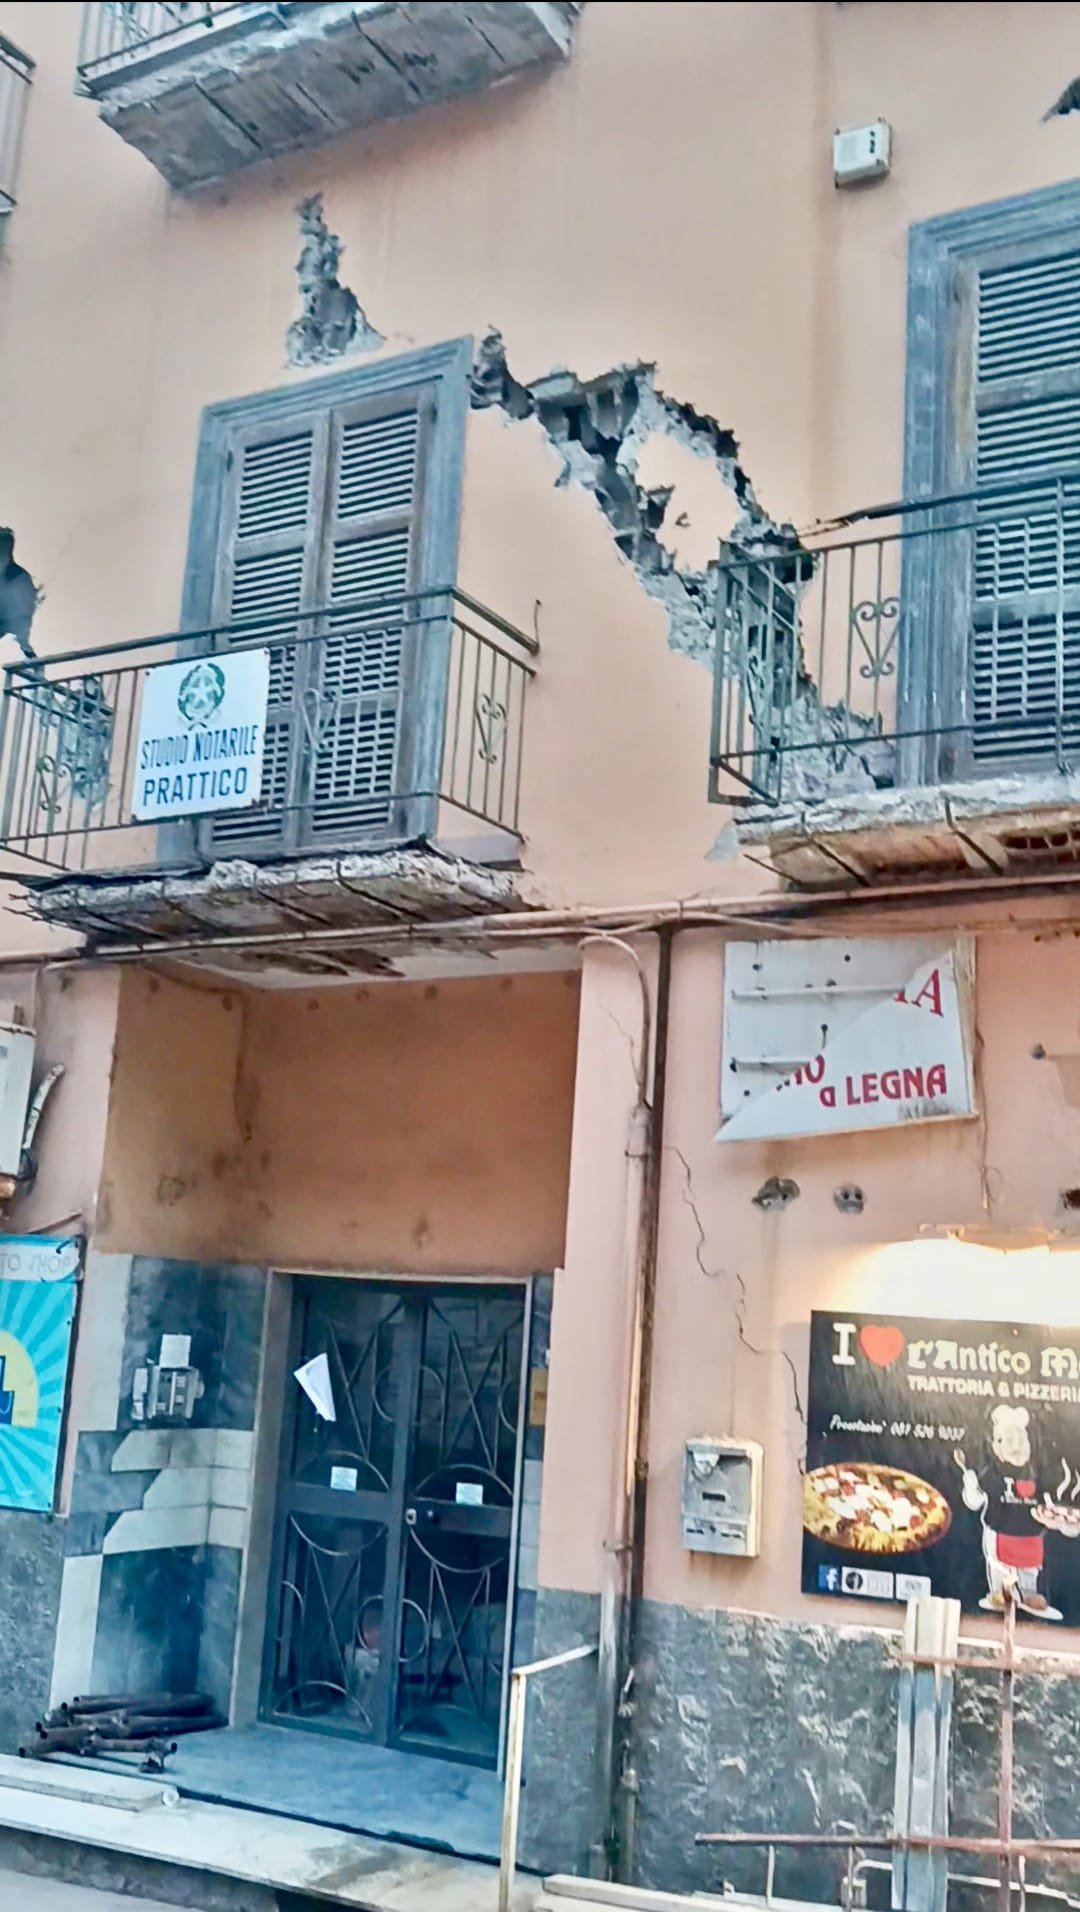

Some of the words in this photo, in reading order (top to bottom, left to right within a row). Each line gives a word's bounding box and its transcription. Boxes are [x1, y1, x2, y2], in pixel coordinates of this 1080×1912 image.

[140, 734, 188, 769] STUDIO
[193, 724, 259, 762] NOTARILE
[143, 767, 248, 806] PRATTICO
[845, 1063, 948, 1106] LEGNA
[832, 1322, 857, 1366] I
[907, 1375, 995, 1397] TRATTORIA
[1013, 1382, 1080, 1404] PIZZERI
